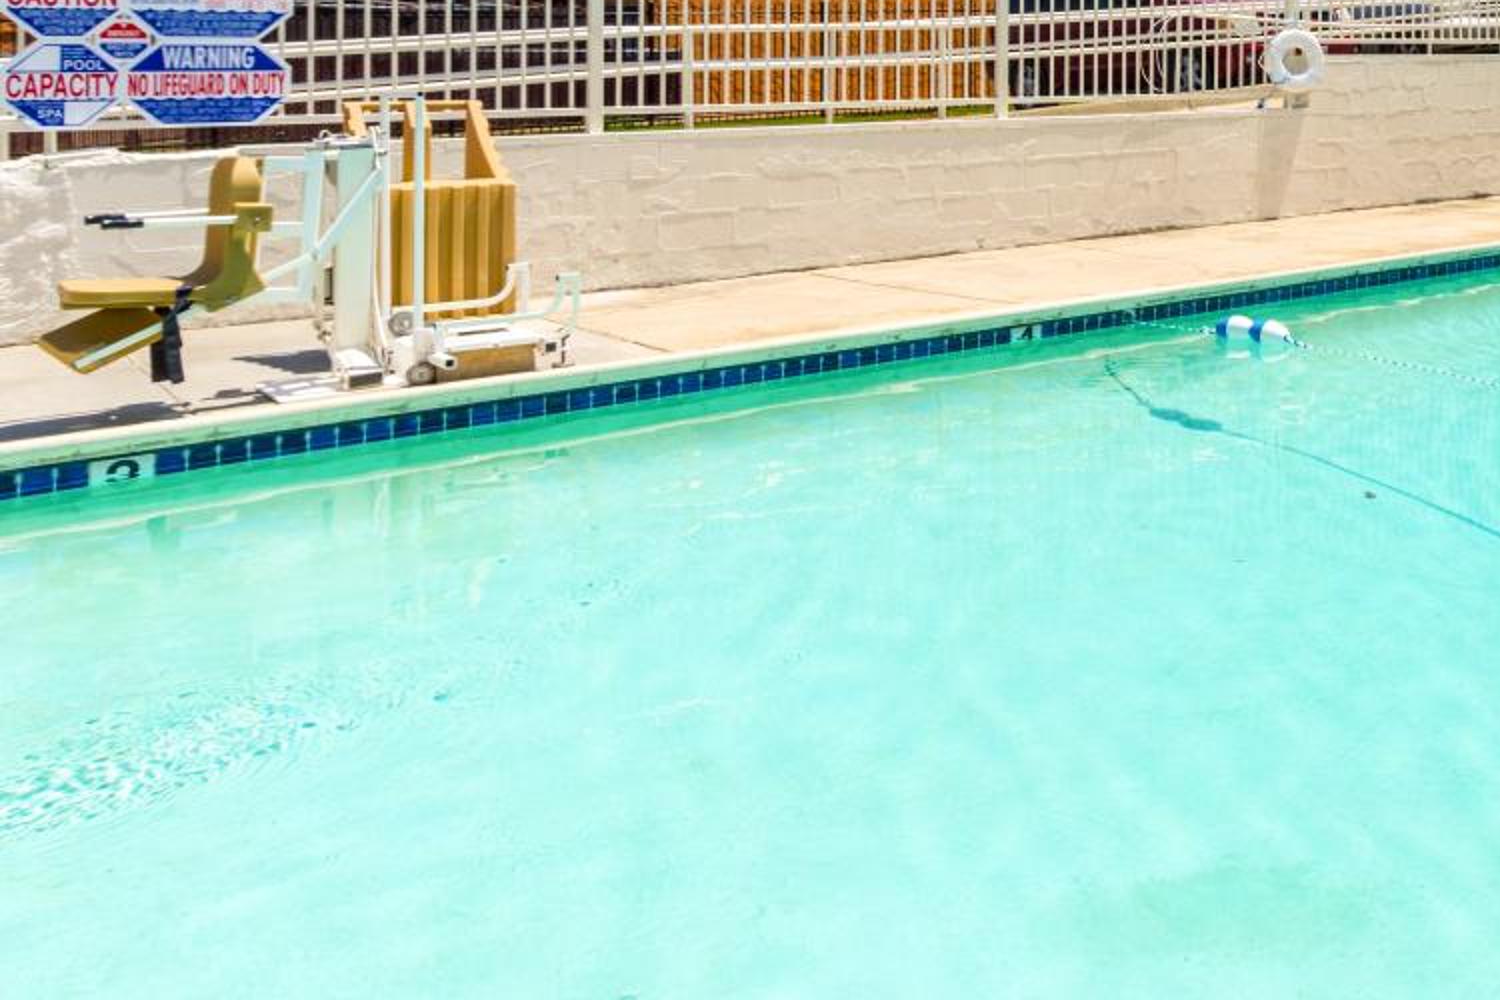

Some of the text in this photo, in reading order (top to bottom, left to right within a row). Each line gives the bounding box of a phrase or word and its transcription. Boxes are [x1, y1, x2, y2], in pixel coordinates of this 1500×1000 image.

[64, 60, 105, 70] POOL
[162, 46, 256, 69] WARNING
[6, 73, 118, 98] CAPACITY
[128, 72, 285, 96] NO LIFEGUARD ON DUTY
[37, 109, 63, 119] SPA
